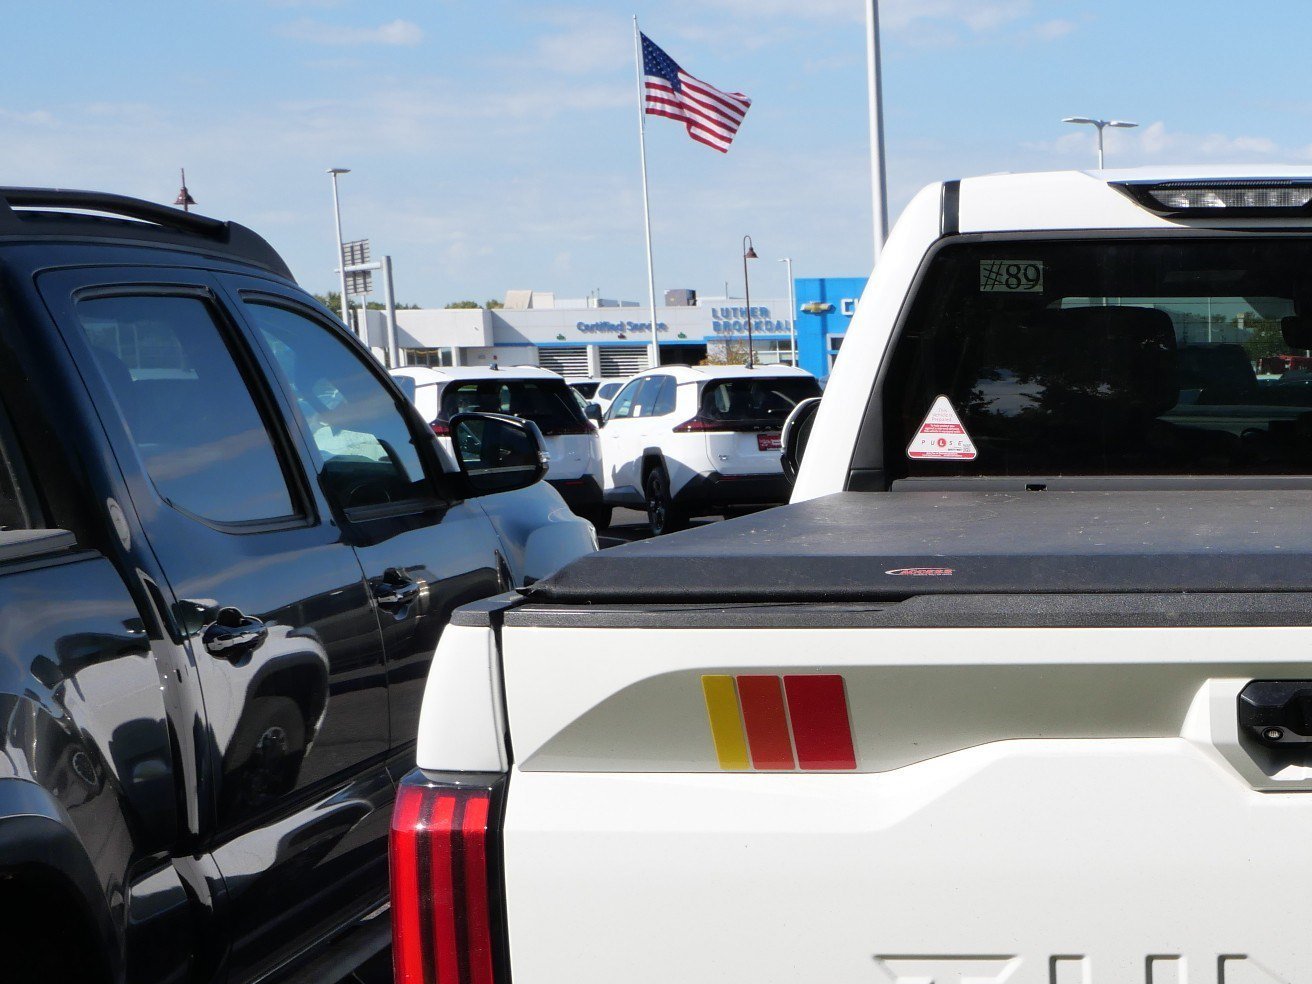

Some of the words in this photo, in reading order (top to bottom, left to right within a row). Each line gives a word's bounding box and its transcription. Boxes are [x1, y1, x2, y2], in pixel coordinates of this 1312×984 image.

[983, 261, 1041, 290] #89
[711, 307, 770, 320] LUTHER
[626, 321, 669, 333] Servie
[712, 320, 797, 333] BROOKDAL
[921, 438, 963, 447] PULSE
